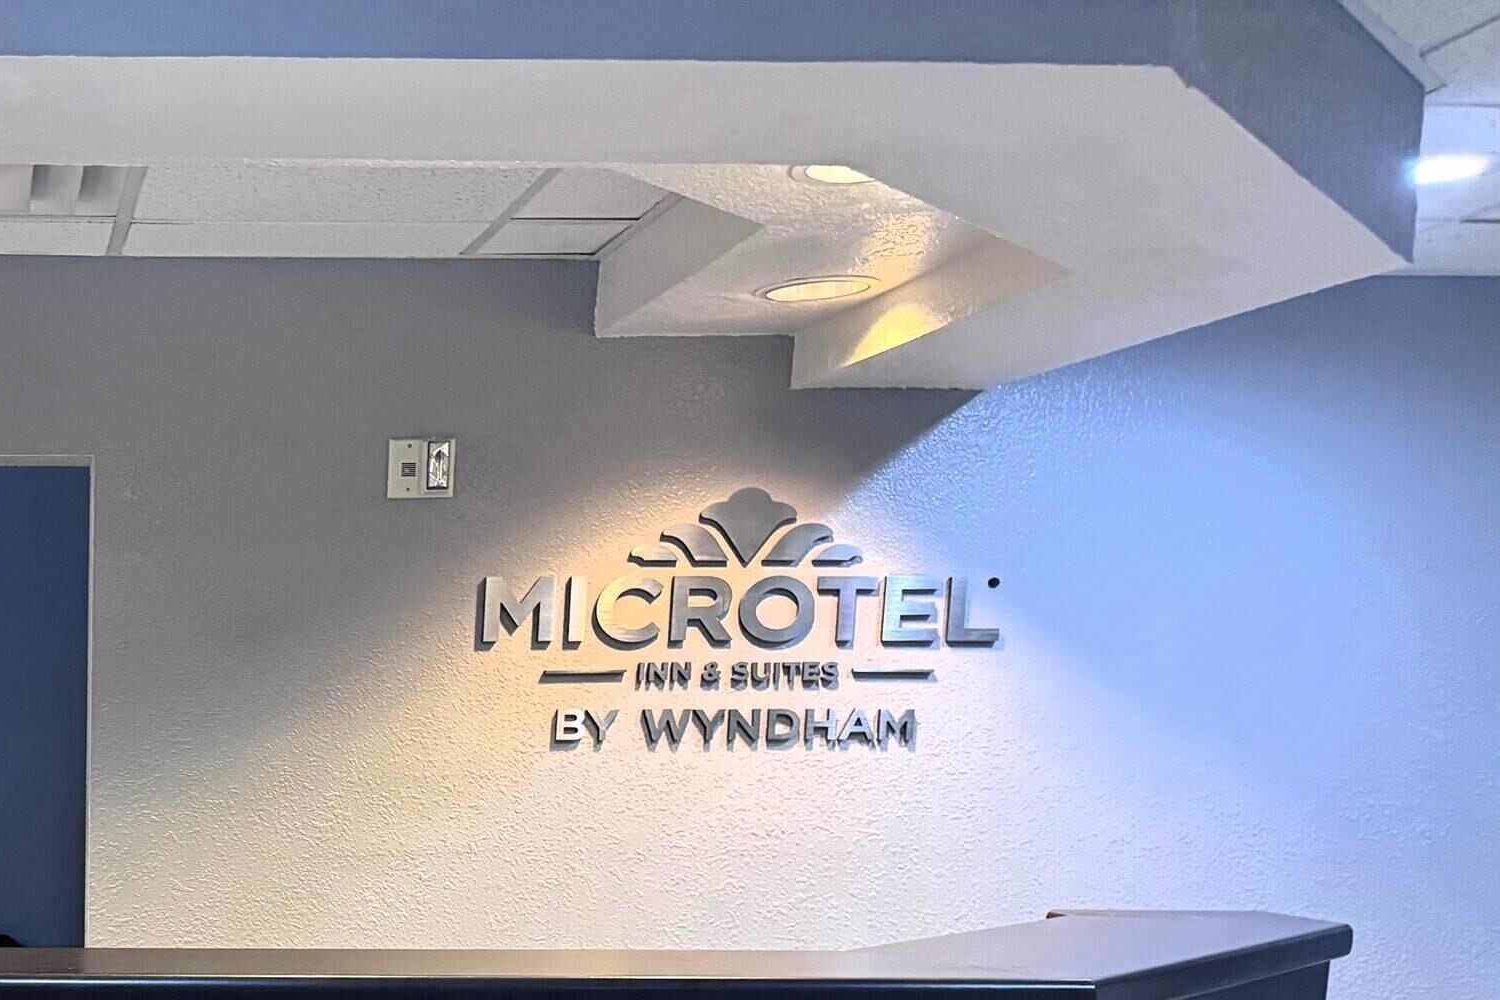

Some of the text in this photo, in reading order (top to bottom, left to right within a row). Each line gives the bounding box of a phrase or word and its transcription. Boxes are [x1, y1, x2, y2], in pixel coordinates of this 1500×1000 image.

[476, 575, 1001, 648] MICROTEL
[636, 662, 839, 687] INN & SUITES
[552, 708, 917, 748] BY WYNDHAM
